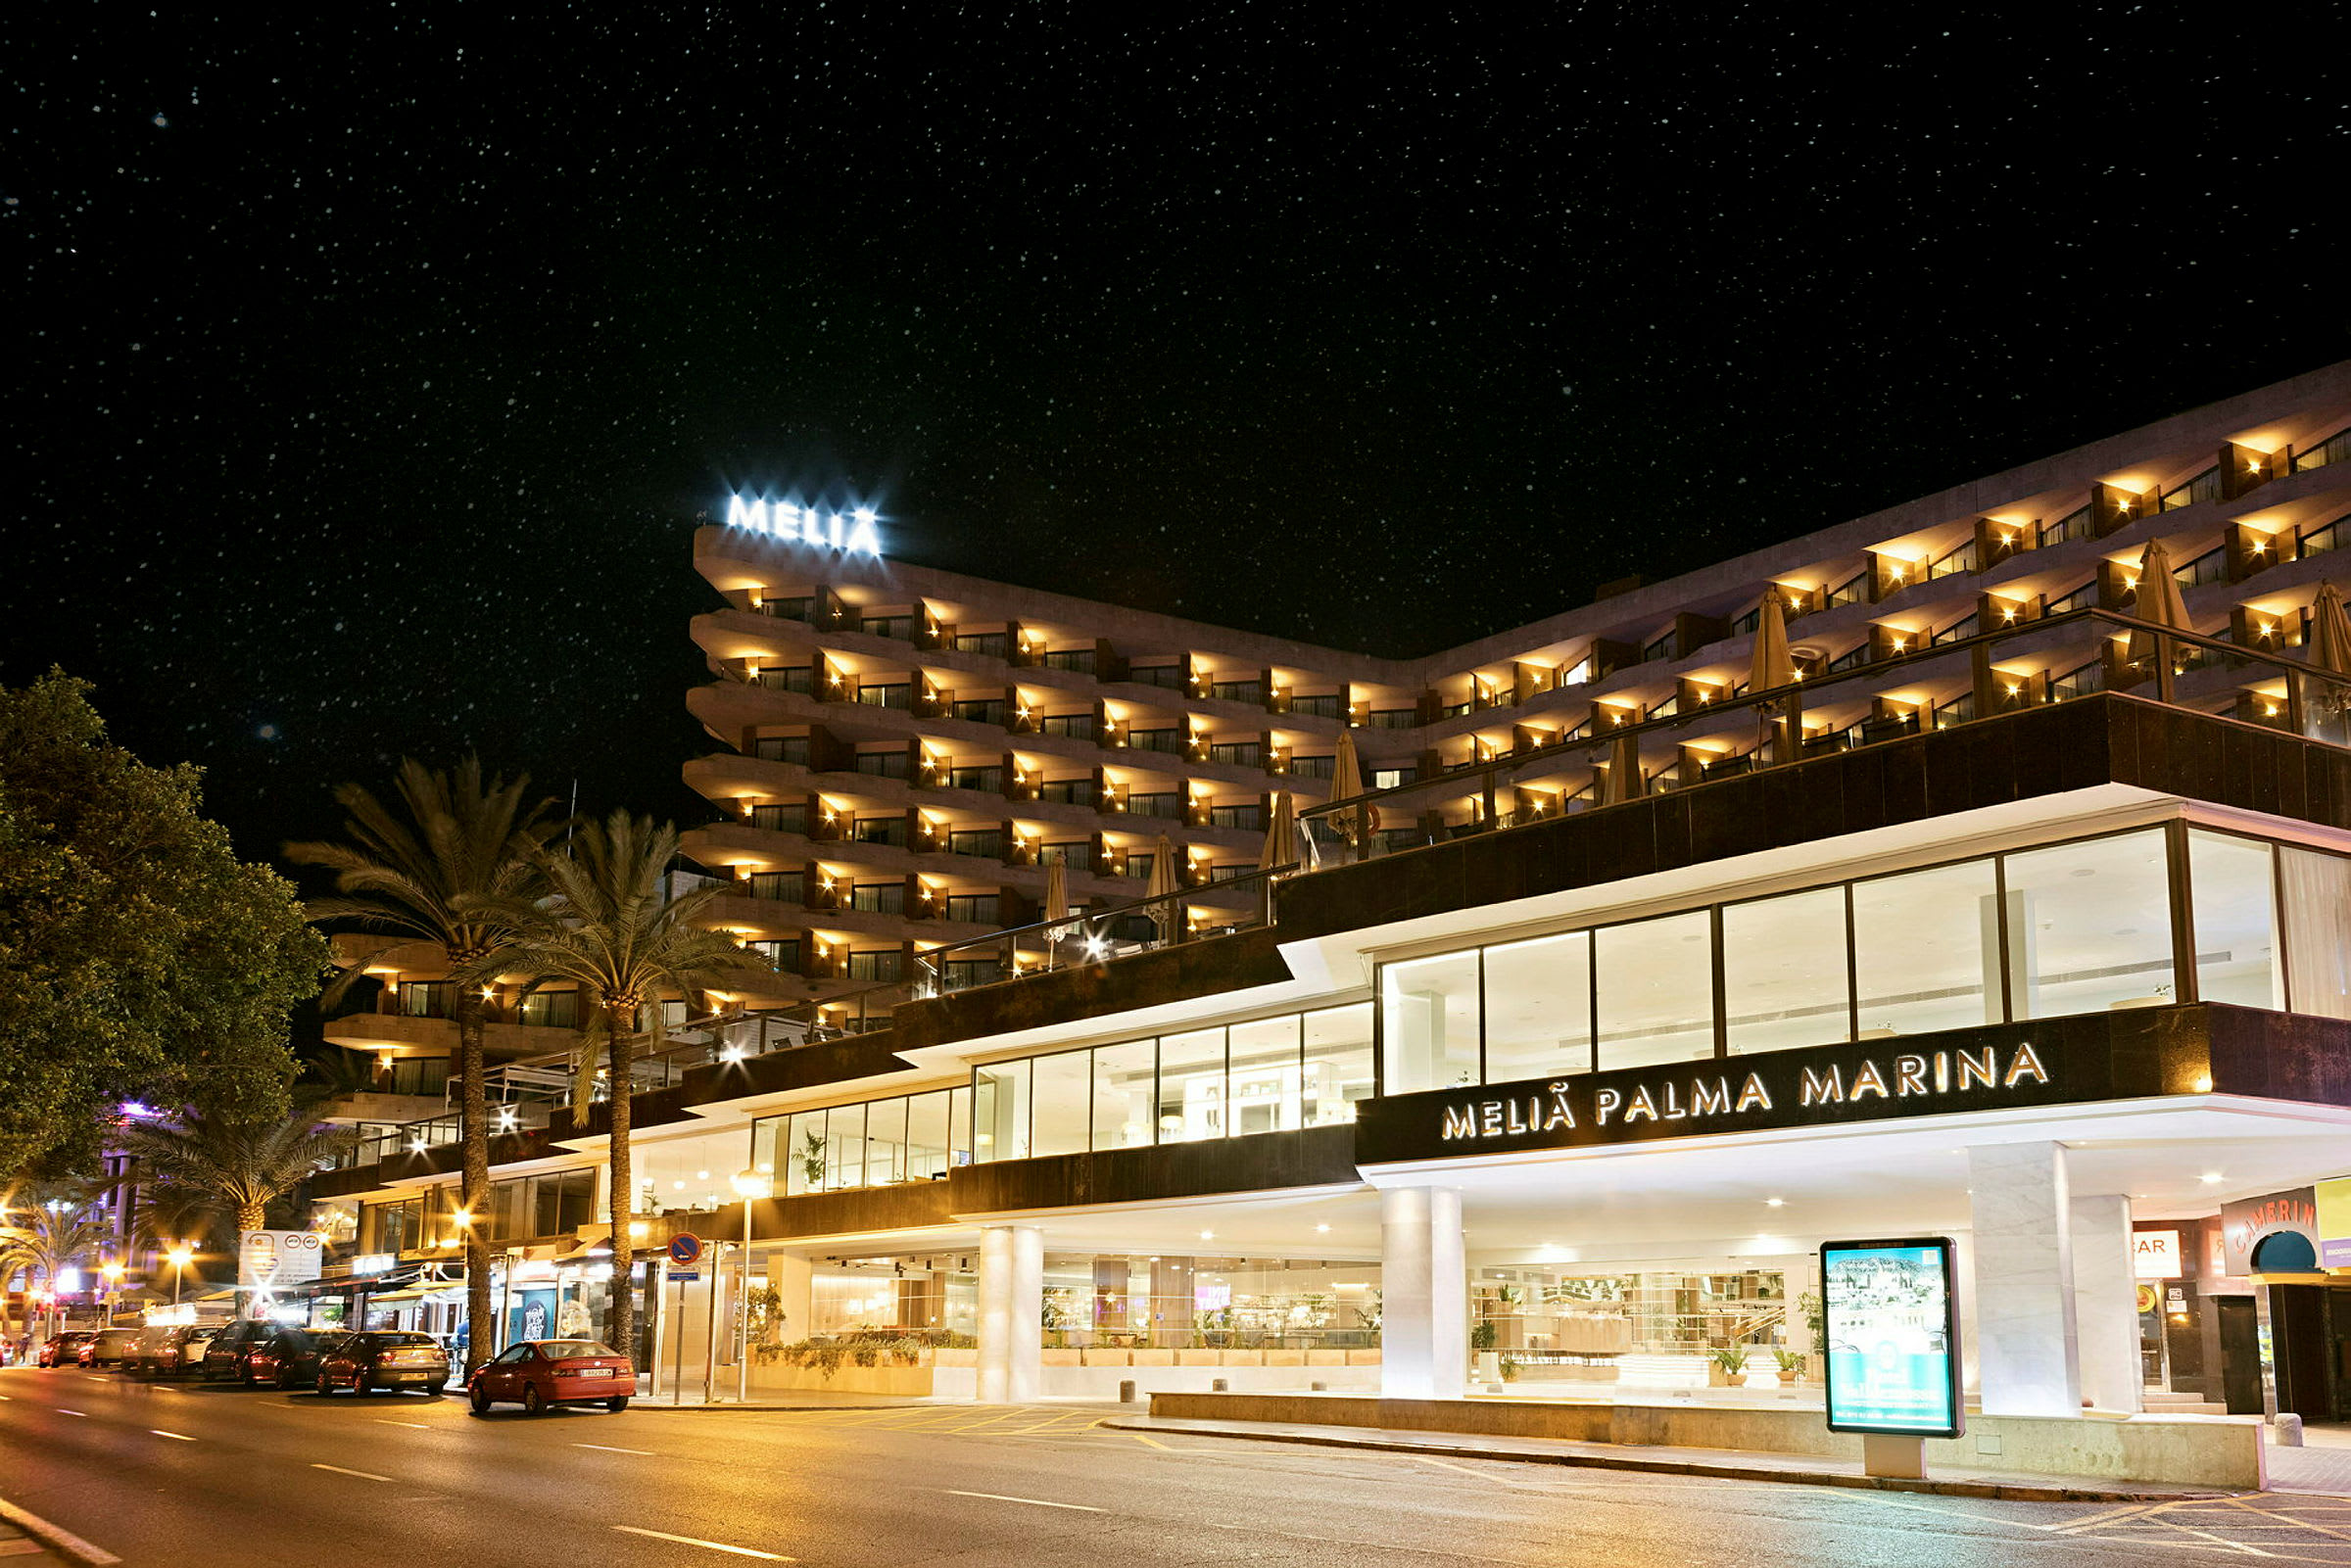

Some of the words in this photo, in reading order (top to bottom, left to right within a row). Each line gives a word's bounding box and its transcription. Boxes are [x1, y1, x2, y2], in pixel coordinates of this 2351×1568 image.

[1596, 1071, 1773, 1126] PALMA
[1799, 1041, 2049, 1107] MARINA
[2133, 1239, 2167, 1255] AR
[2233, 1199, 2316, 1256] CAMERIN
